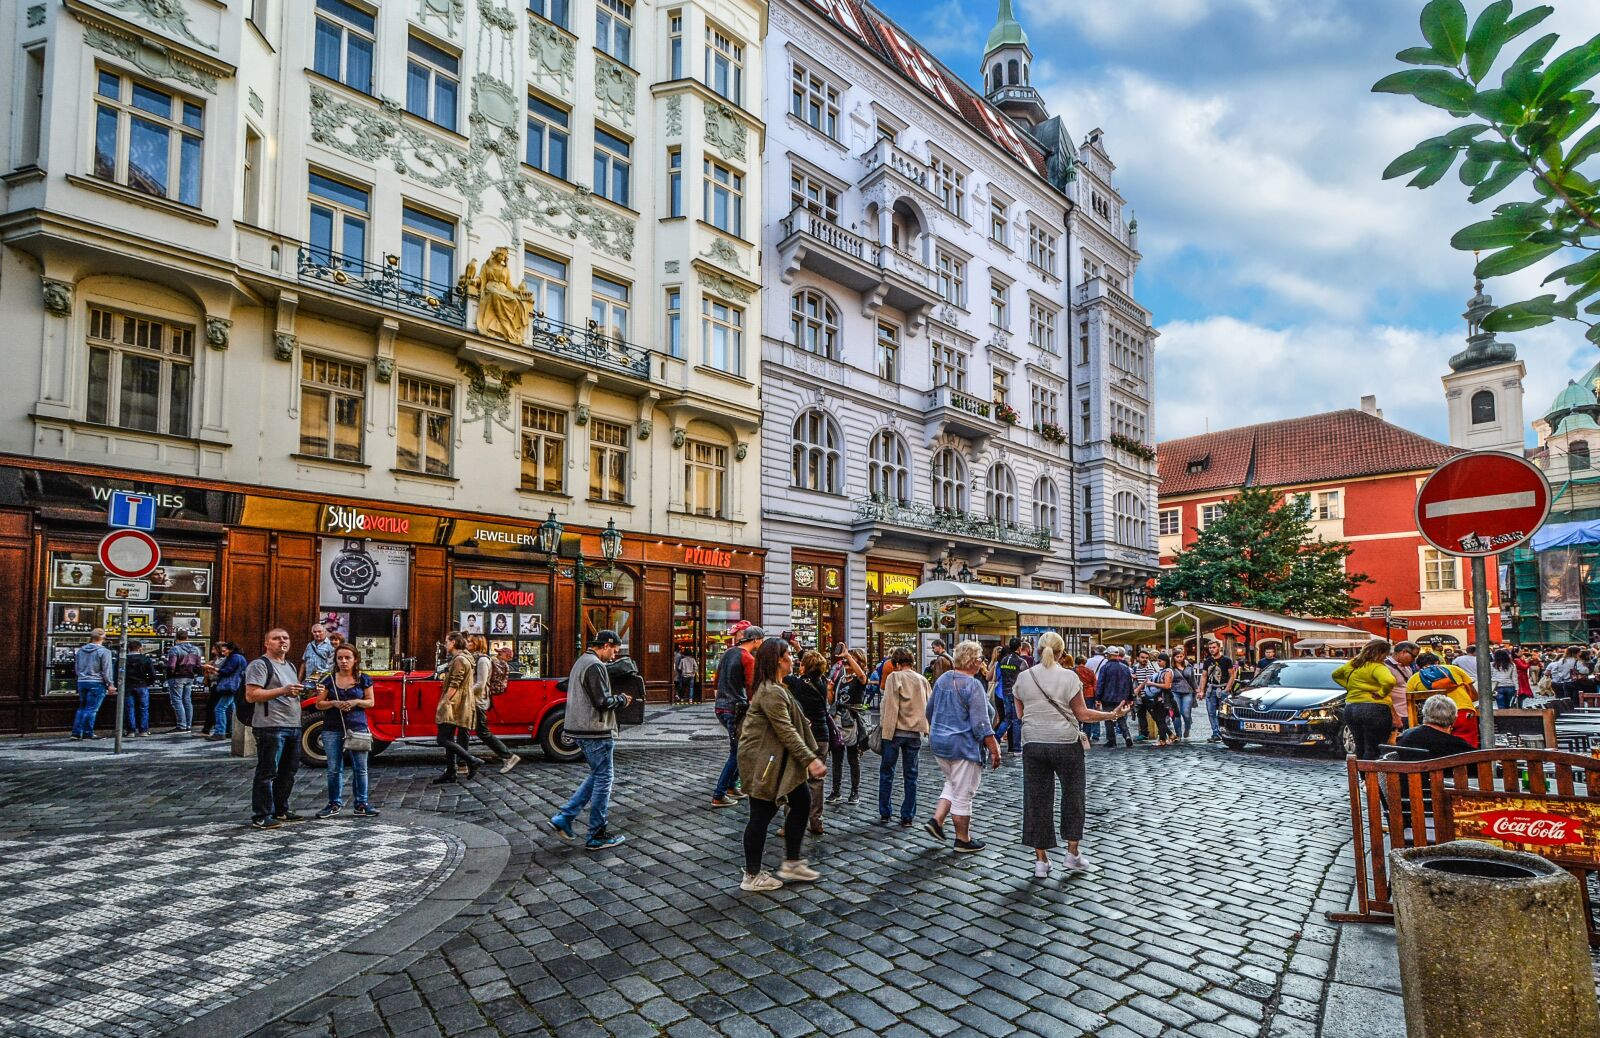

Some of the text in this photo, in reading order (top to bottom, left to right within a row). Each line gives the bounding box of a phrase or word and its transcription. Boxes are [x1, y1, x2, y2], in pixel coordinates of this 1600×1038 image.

[91, 486, 183, 508] WHES
[473, 529, 537, 546] JEWELLERY
[684, 548, 732, 568] PYLONES
[884, 575, 918, 591] MARKET
[1260, 723, 1277, 731] 5141
[1493, 816, 1567, 840] Coca-Cola
